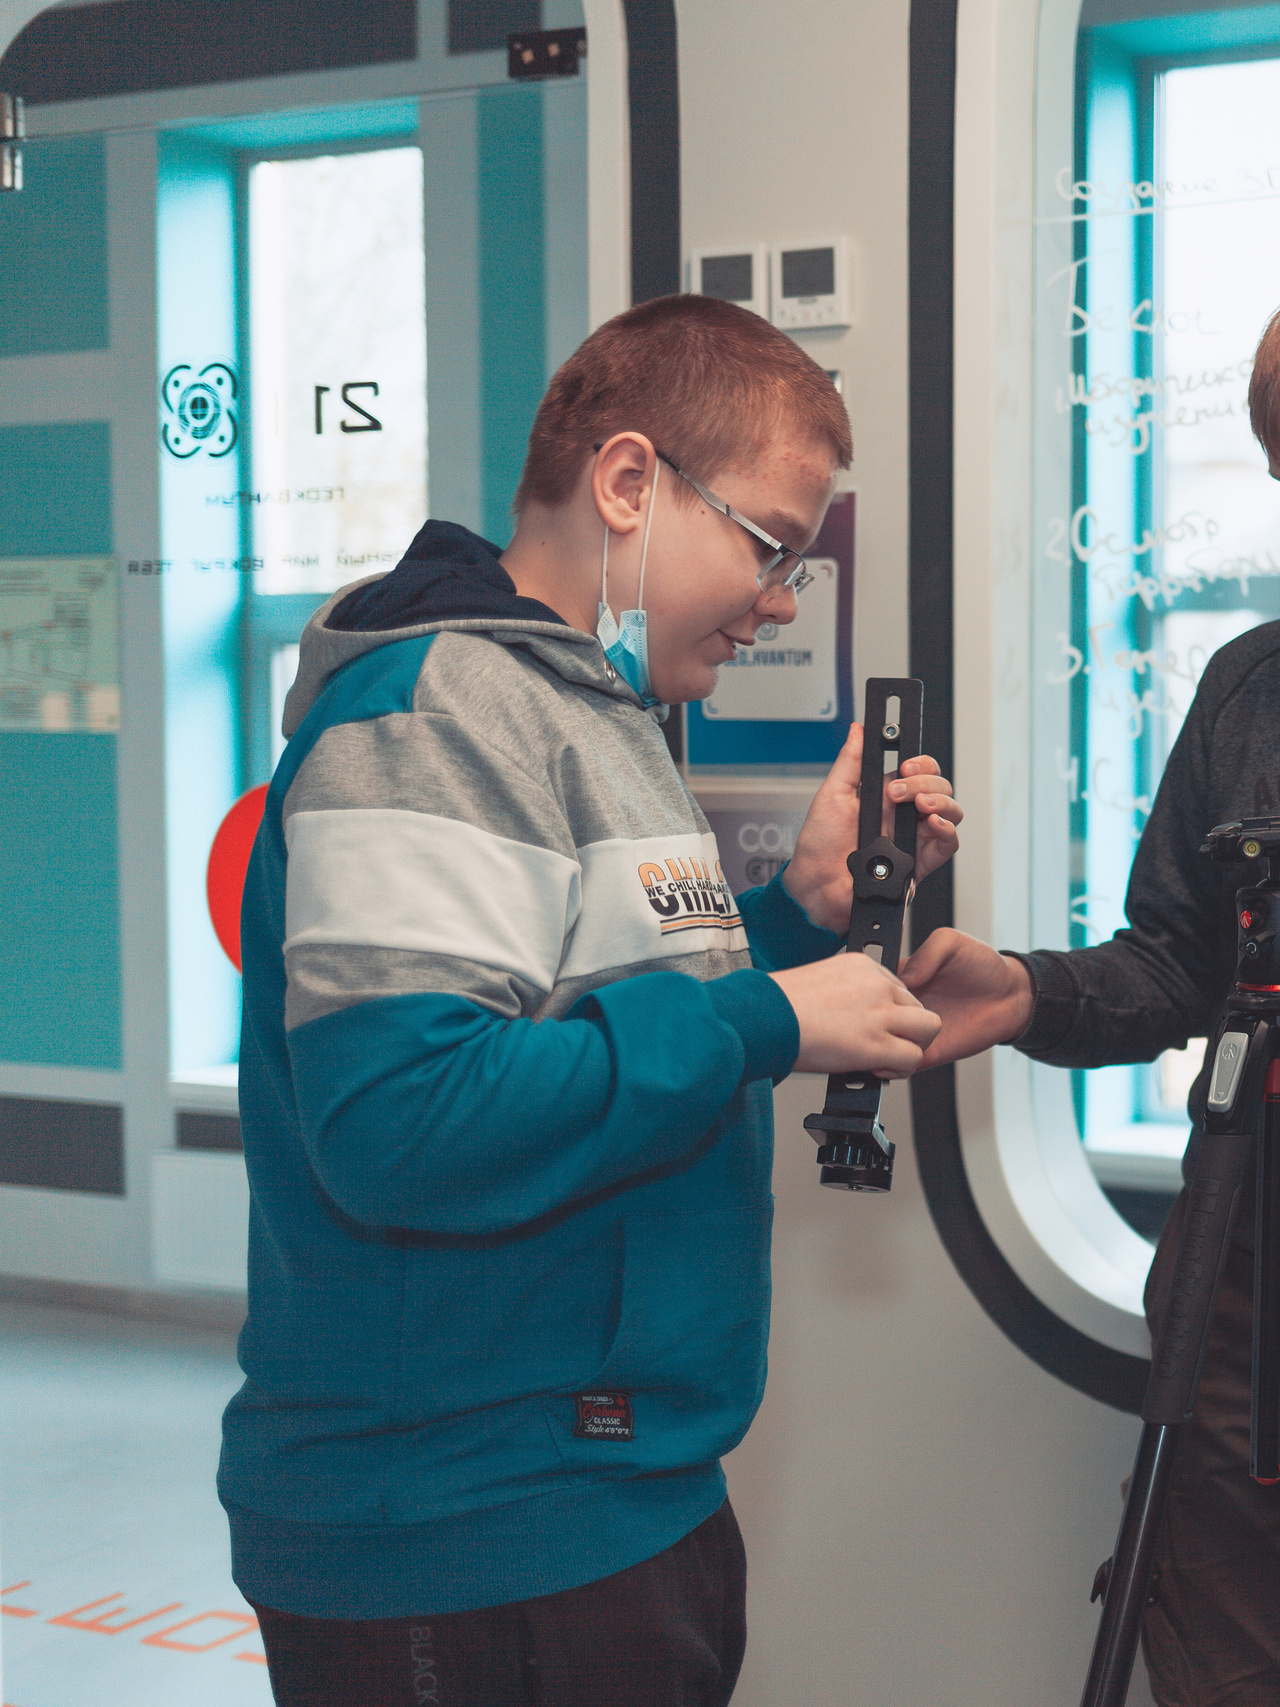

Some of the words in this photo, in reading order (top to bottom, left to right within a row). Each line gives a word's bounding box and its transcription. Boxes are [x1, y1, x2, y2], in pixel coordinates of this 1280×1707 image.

[644, 885, 665, 898] WE
[667, 880, 697, 893] CHILL
[593, 1417, 621, 1425] CLASSIC
[409, 1625, 441, 1707] BLACK
